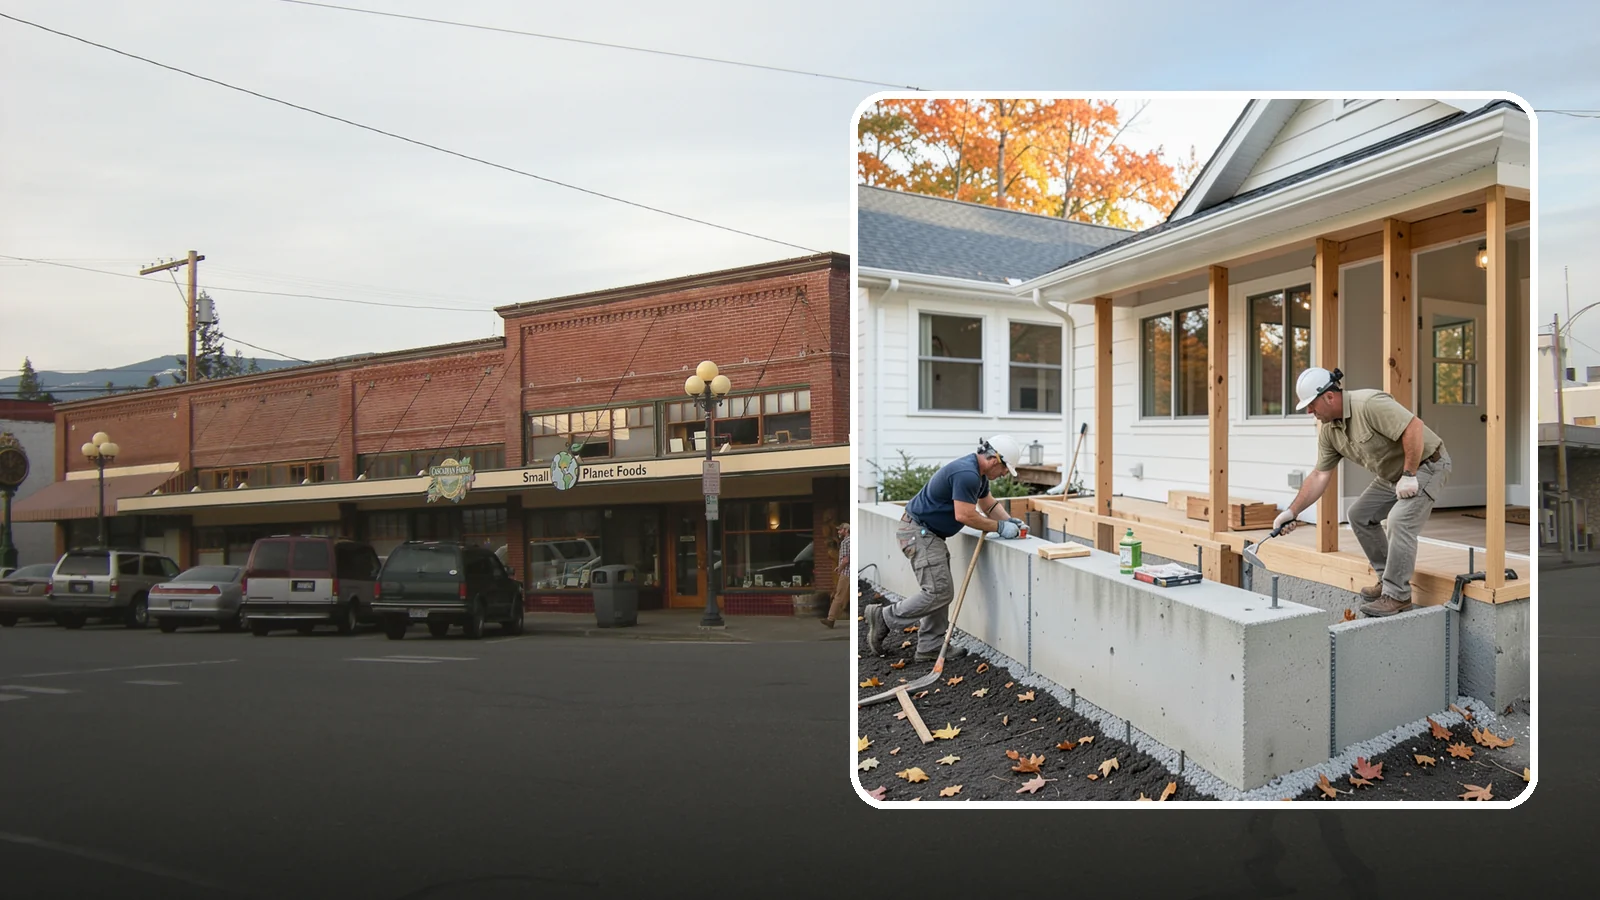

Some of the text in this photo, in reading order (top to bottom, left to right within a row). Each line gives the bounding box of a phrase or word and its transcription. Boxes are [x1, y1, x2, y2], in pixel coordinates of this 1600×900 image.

[523, 464, 647, 483] Small Planet Foods
